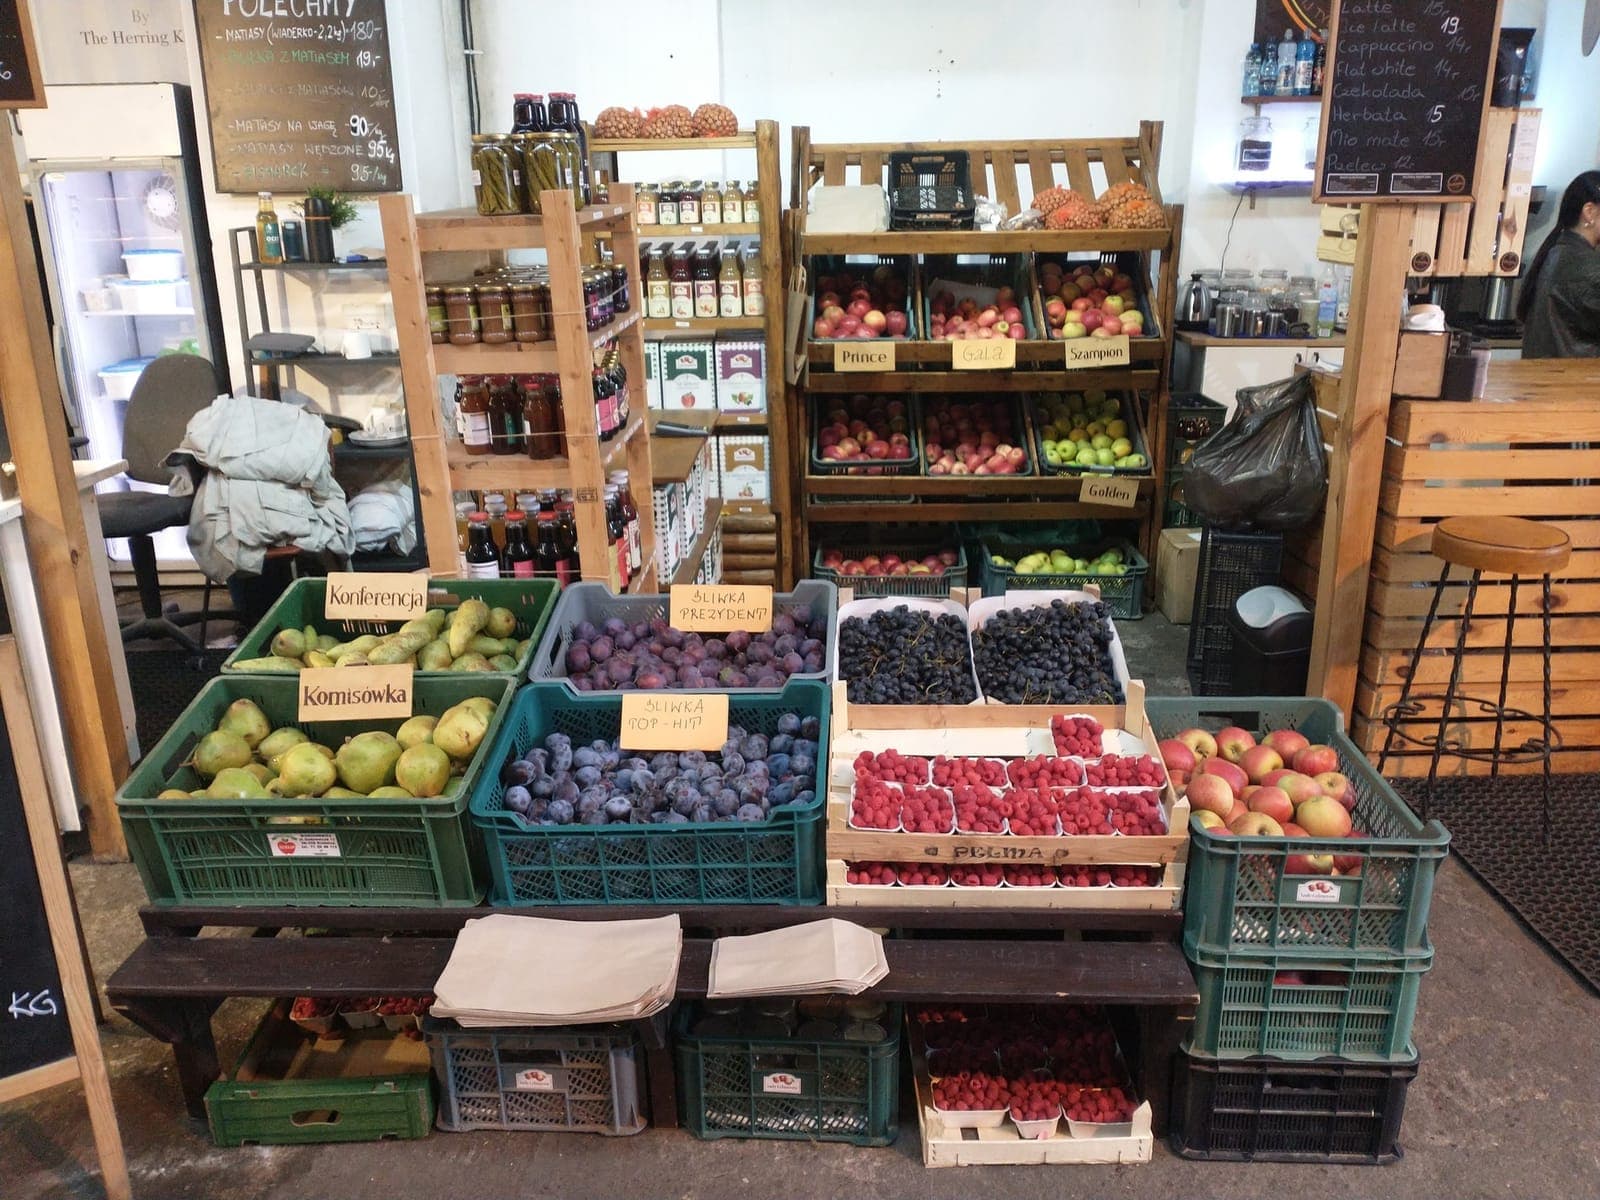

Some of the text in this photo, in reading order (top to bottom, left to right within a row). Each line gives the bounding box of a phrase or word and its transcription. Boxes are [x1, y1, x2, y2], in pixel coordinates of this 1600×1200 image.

[1341, 0, 1392, 14] Latte
[131, 9, 149, 26] By
[1373, 18, 1416, 33] latte
[80, 31, 108, 45] The
[112, 31, 169, 47] Herring
[1339, 40, 1434, 59] Cappuccino
[1337, 61, 1367, 77] Flat
[1373, 59, 1417, 77] white
[1333, 82, 1425, 99] Czekolada
[1333, 104, 1407, 122] Herbata
[287, 120, 303, 132] NA
[1330, 128, 1357, 147] Mio
[1367, 129, 1410, 148] mate
[842, 350, 887, 363] Prince
[962, 345, 1003, 361] Gala
[1070, 346, 1123, 361] Szampion
[1089, 483, 1130, 500] Golden
[330, 585, 423, 612] Konferencja
[679, 607, 767, 620] PREZYDENT
[303, 684, 407, 706] Komisówka
[8, 989, 57, 1019] KG
